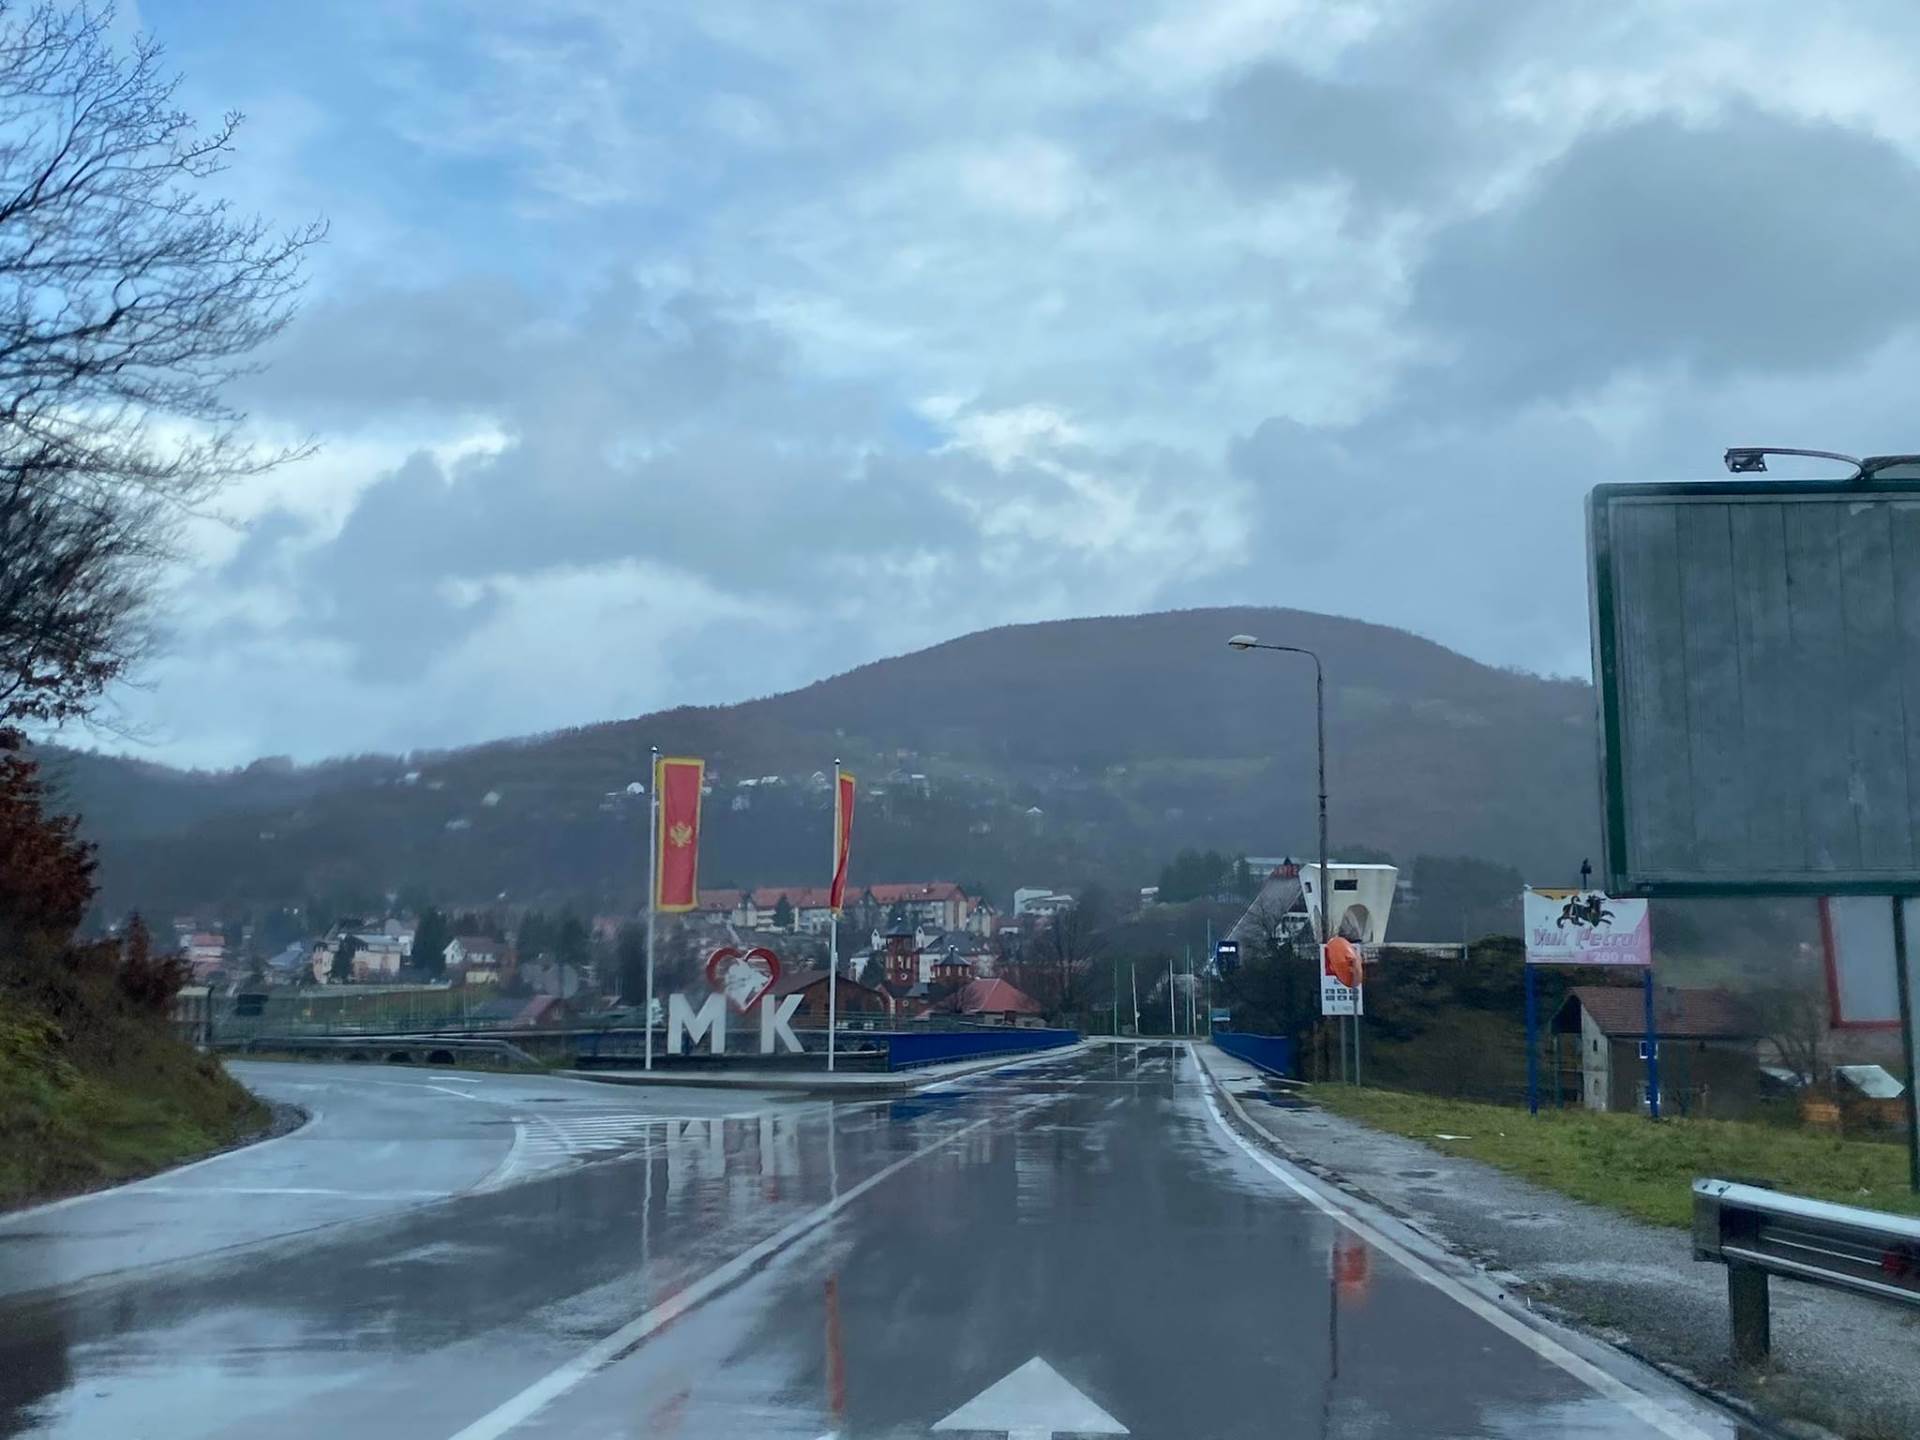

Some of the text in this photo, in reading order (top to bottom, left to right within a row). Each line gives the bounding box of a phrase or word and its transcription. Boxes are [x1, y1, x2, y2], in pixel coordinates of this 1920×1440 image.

[1576, 928, 1640, 948] Petrol
[667, 993, 805, 1054] M K
